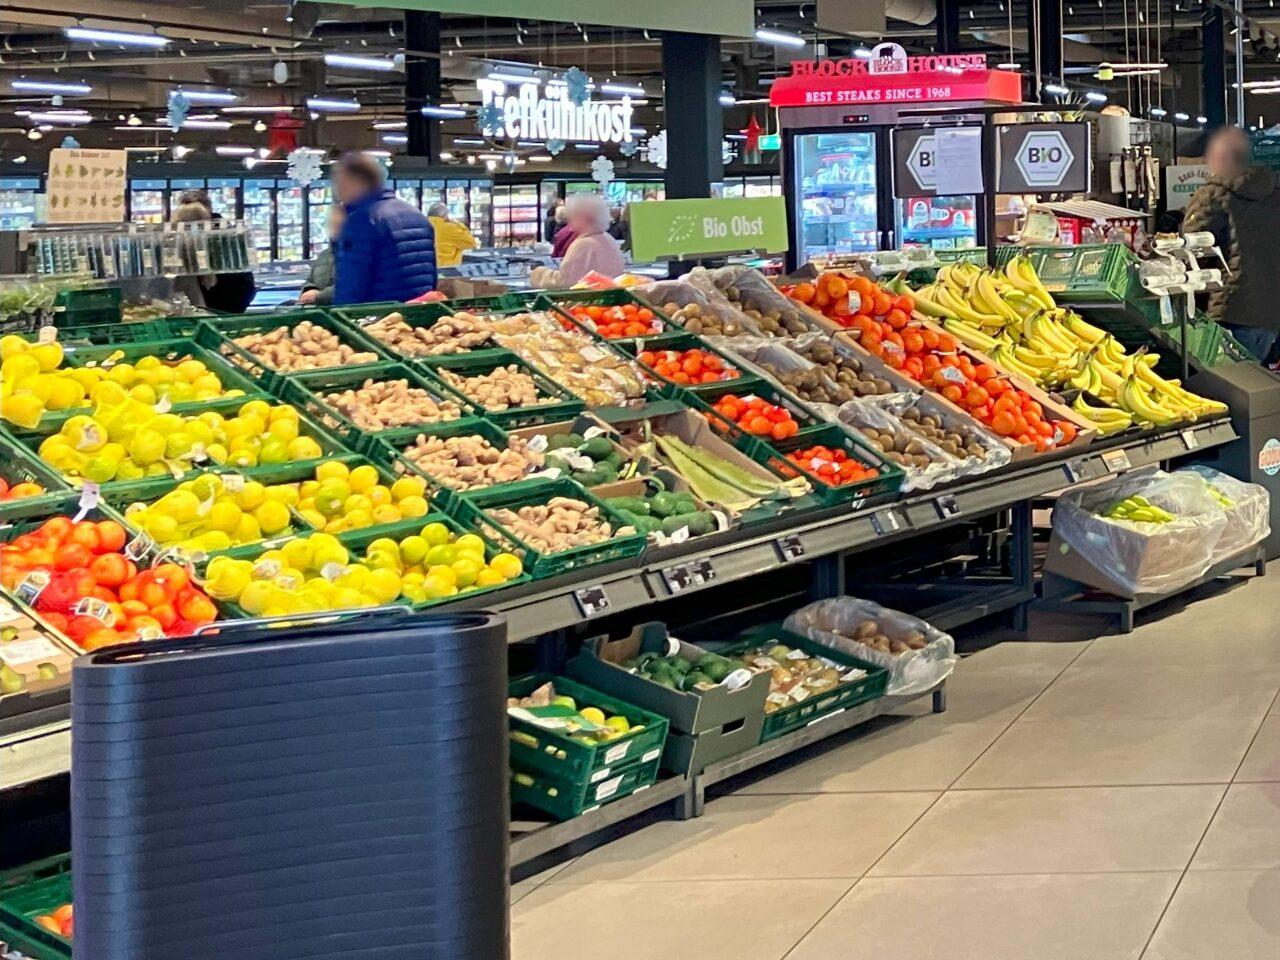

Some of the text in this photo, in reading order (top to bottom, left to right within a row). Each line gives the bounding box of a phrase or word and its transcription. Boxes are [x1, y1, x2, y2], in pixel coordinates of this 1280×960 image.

[791, 53, 987, 77] BLOCK HOUSE
[806, 86, 951, 103] BEST STEAKS SINCE 1968
[703, 215, 764, 238] Bio Obst
